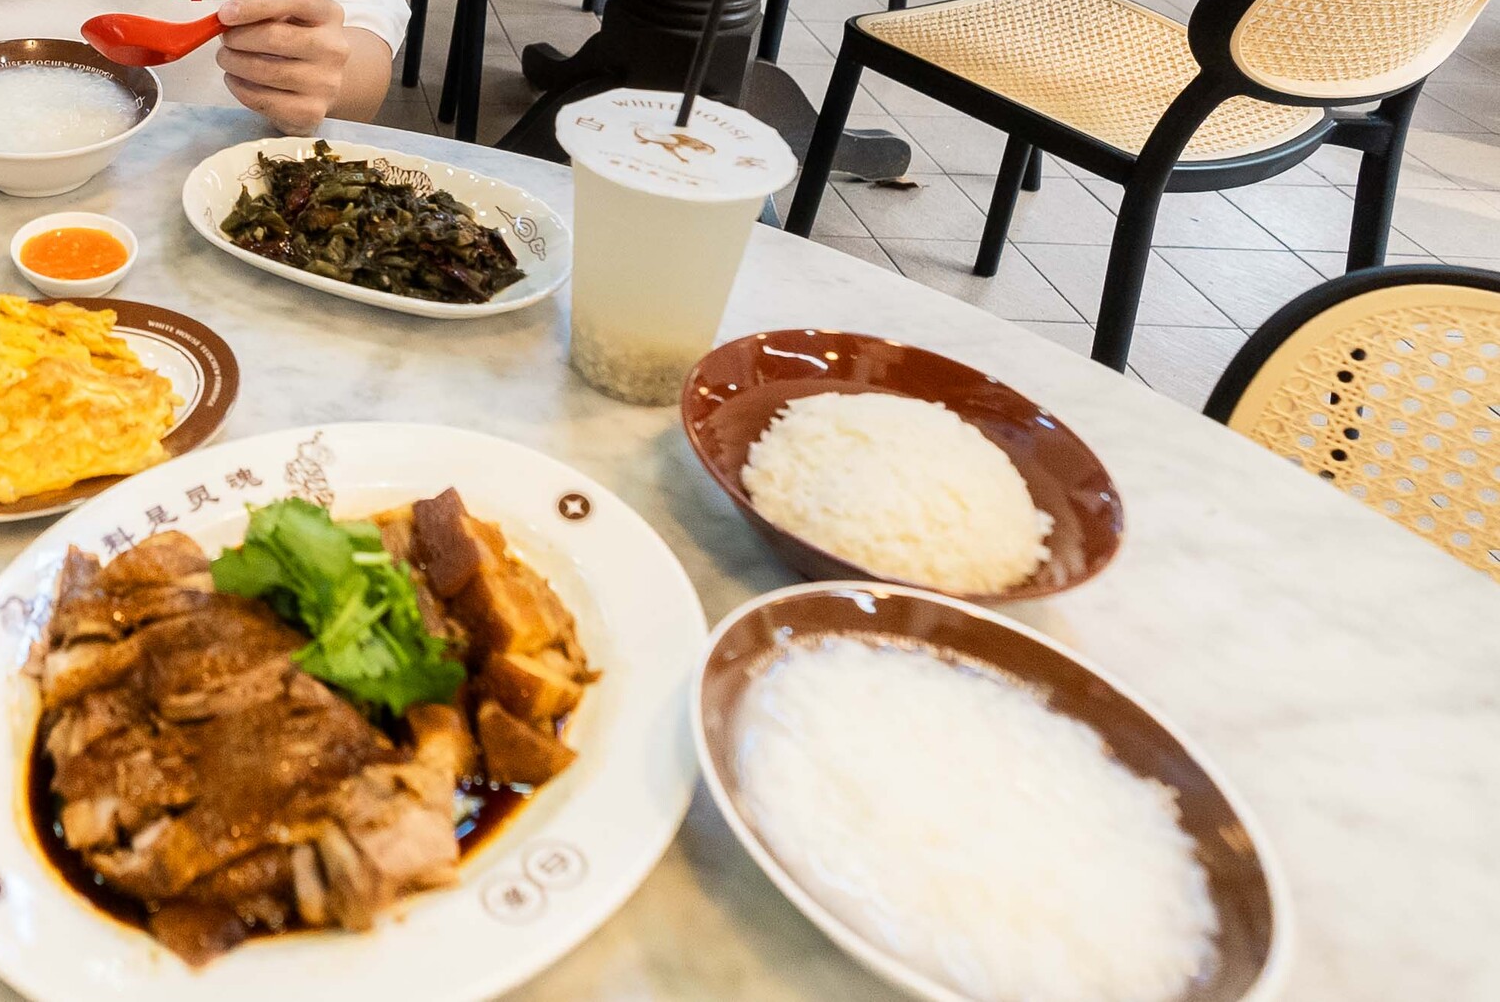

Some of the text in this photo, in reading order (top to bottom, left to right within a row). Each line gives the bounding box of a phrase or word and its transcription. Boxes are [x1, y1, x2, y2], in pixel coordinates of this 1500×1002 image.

[24, 58, 71, 68] TEOCHEW
[73, 63, 115, 80] PORRIDGE
[147, 319, 175, 333] WHITE
[174, 328, 202, 348] HOUSE
